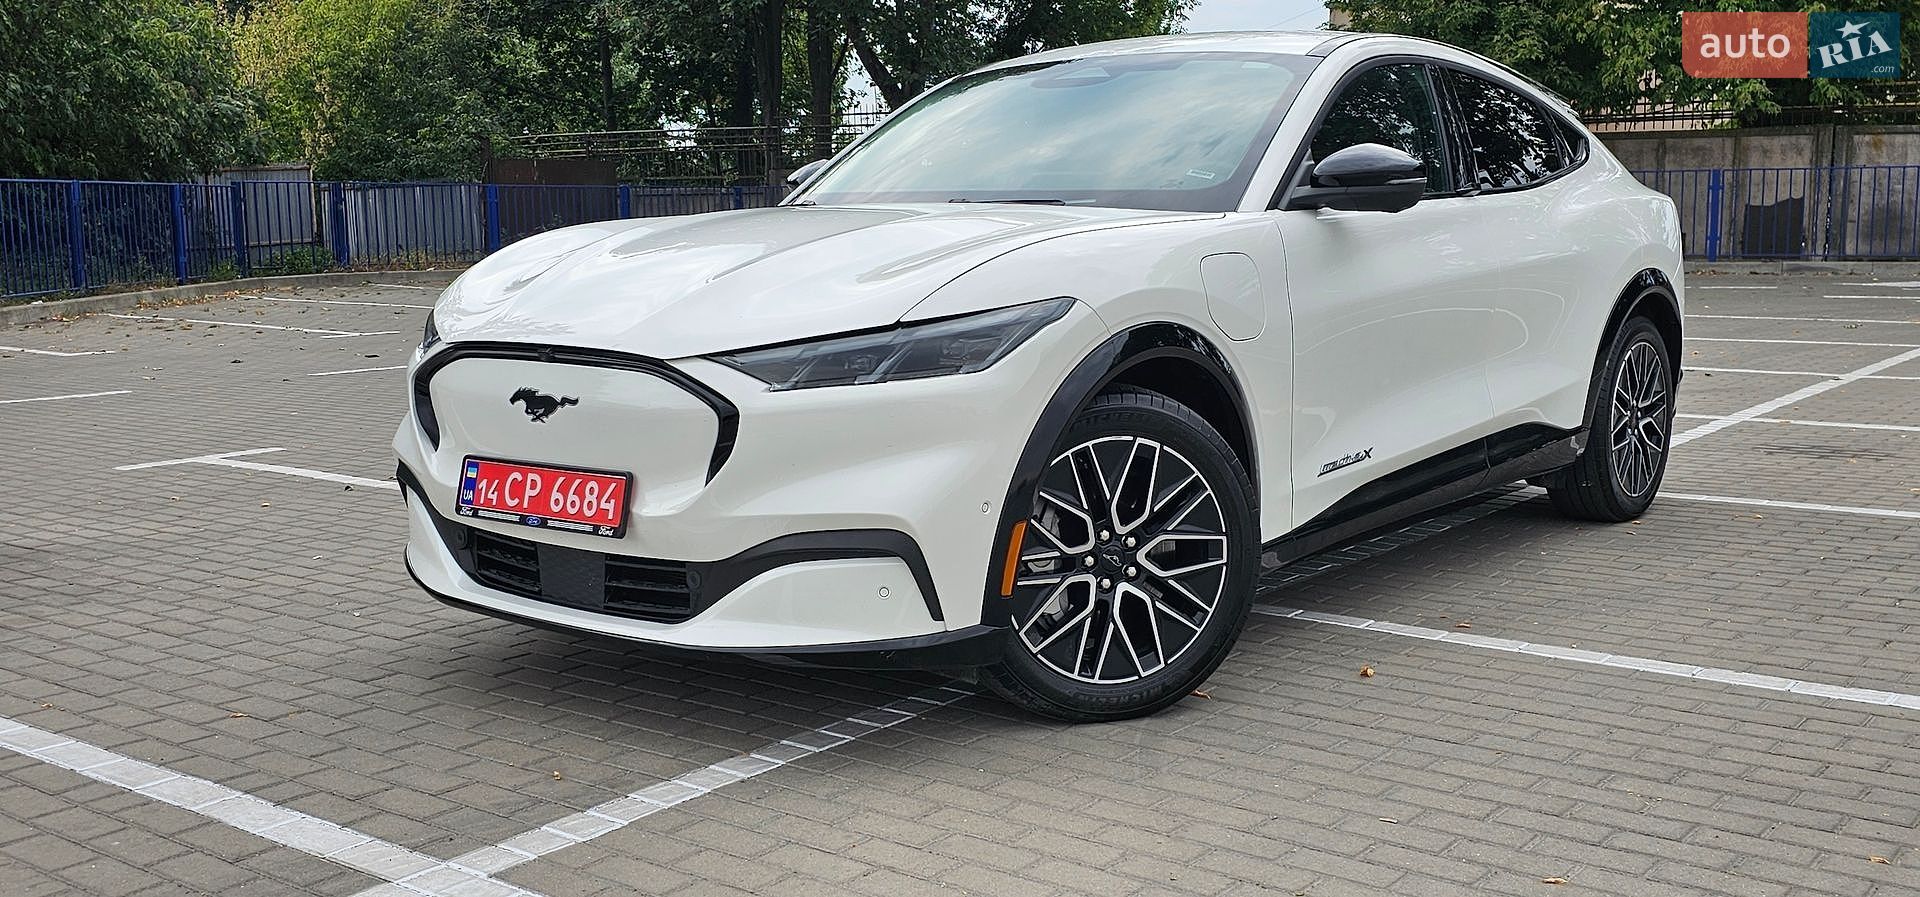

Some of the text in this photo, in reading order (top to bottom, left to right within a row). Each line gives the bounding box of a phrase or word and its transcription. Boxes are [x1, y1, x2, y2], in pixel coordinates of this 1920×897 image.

[463, 489, 474, 501] UA
[478, 471, 617, 520] 14 CP 6684
[598, 526, 614, 536] Ford
